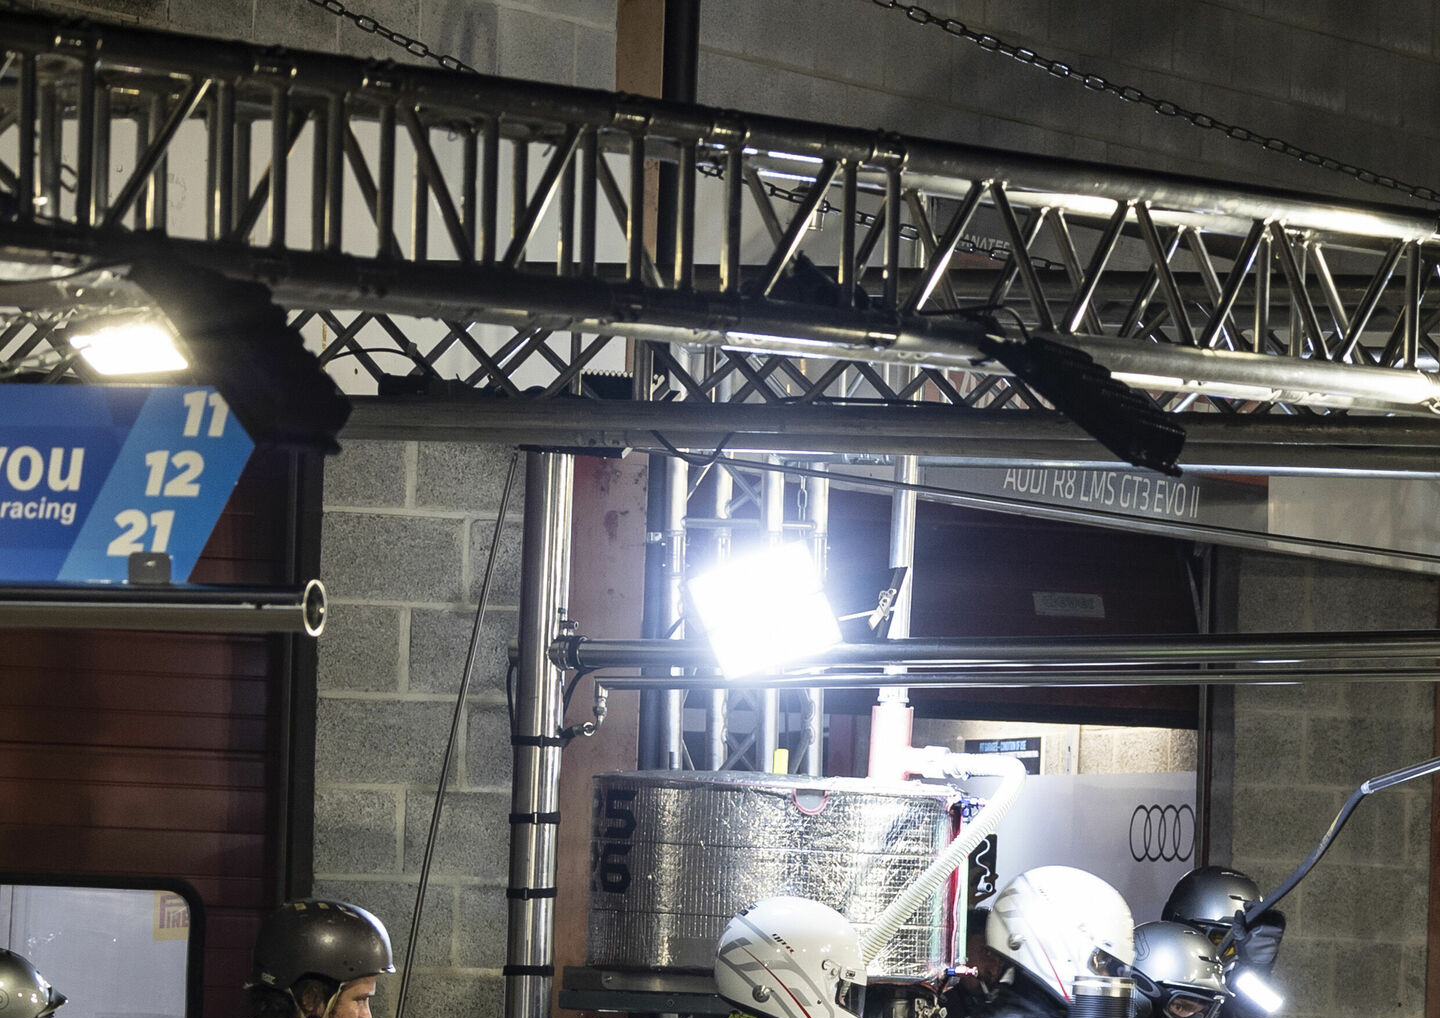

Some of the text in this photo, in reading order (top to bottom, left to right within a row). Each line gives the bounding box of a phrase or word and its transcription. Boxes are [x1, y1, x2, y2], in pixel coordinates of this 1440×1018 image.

[183, 391, 229, 437] 11
[0, 446, 84, 492] ou
[145, 450, 204, 497] 12
[0, 497, 76, 525] racing
[1081, 471, 1116, 505] LMS
[1120, 474, 1149, 511] GT3
[1153, 480, 1186, 516] EVO
[107, 508, 175, 557] 21
